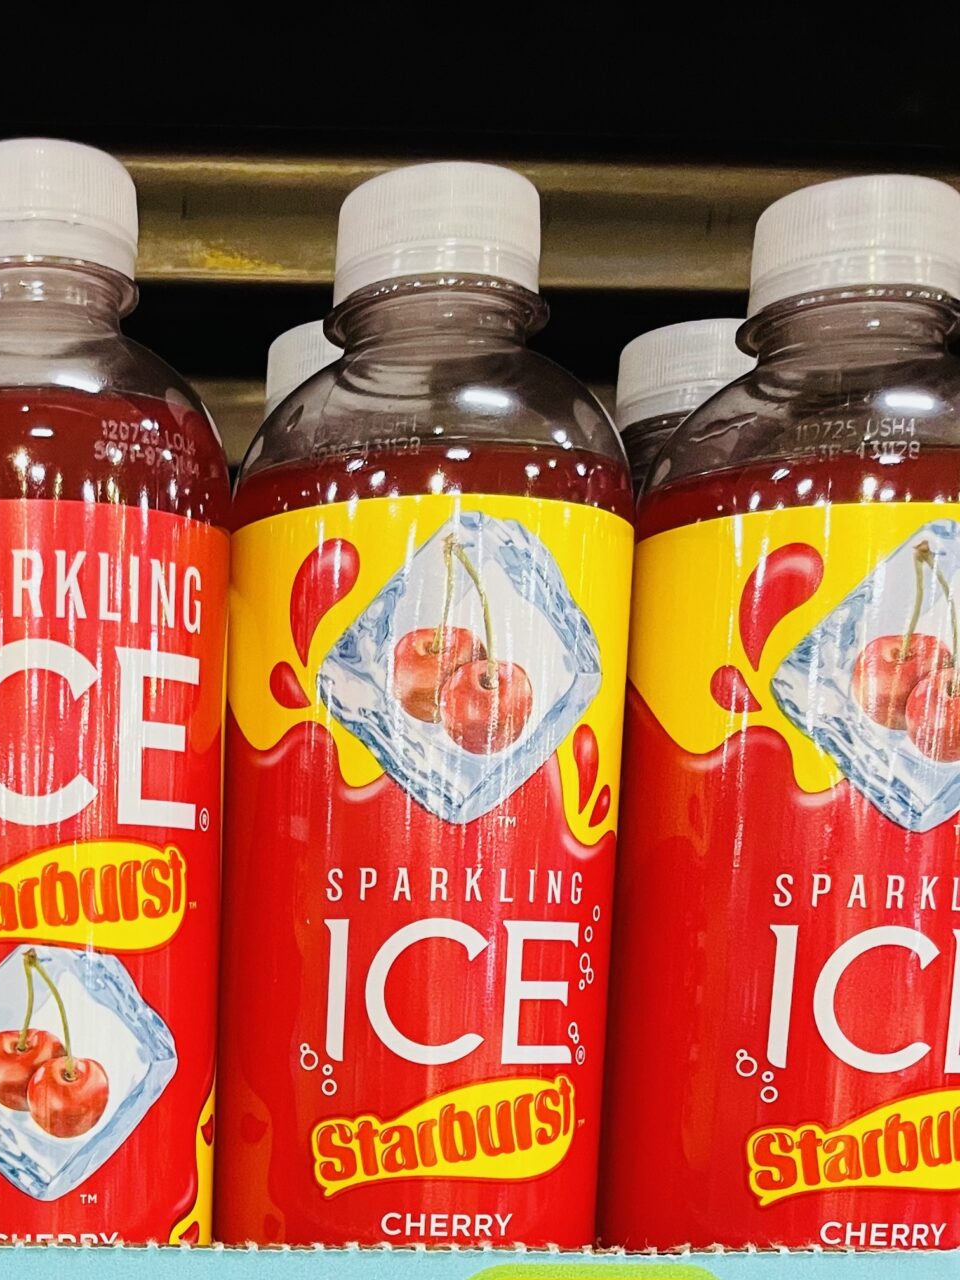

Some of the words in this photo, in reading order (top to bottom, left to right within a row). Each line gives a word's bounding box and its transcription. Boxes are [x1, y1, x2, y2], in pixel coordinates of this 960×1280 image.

[325, 867, 583, 904] SPARKLING
[324, 917, 580, 1065] ICE
[767, 924, 960, 1074] IC
[317, 1078, 571, 1181] Starburst
[381, 1213, 513, 1237] CHERRY
[820, 1221, 946, 1247] CHERRY
